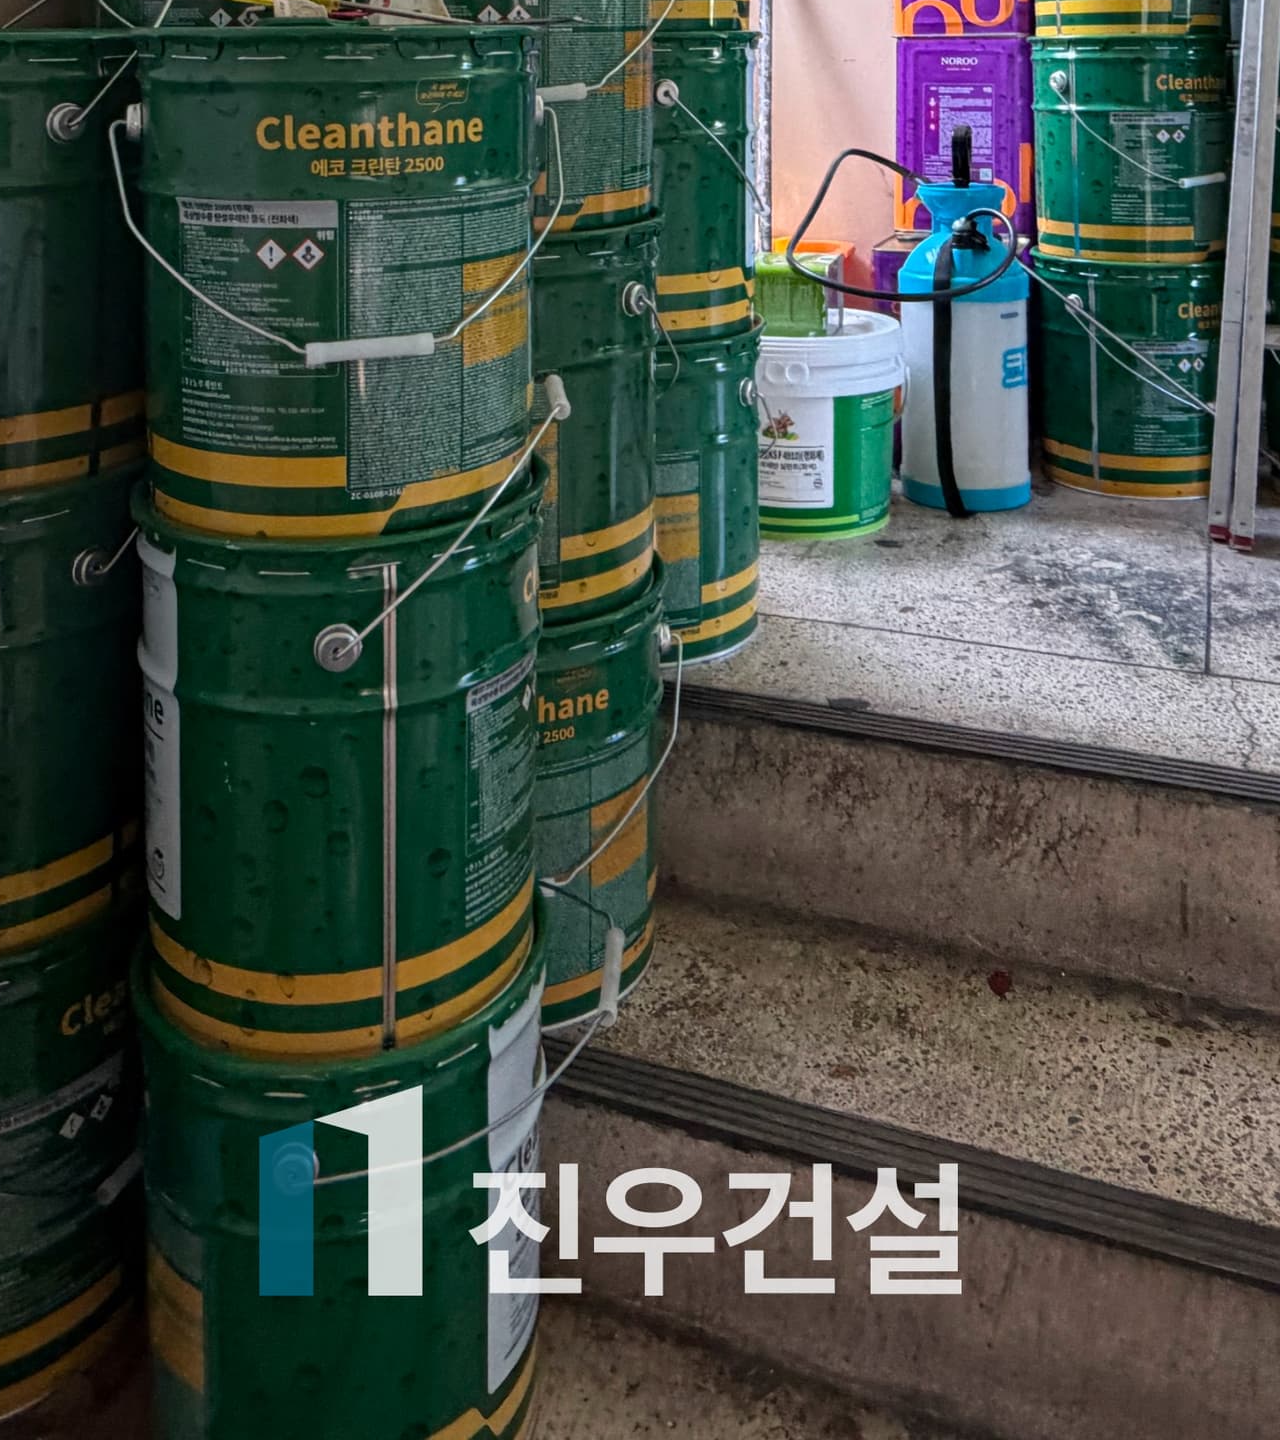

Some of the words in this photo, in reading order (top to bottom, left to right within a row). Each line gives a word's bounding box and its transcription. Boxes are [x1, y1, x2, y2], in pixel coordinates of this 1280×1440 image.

[941, 56, 978, 66] NOROO
[256, 112, 484, 151] Cleanthane
[310, 157, 345, 177] 에코
[351, 157, 401, 176] 크린탄
[404, 155, 445, 173] 2500
[543, 726, 575, 744] 2500
